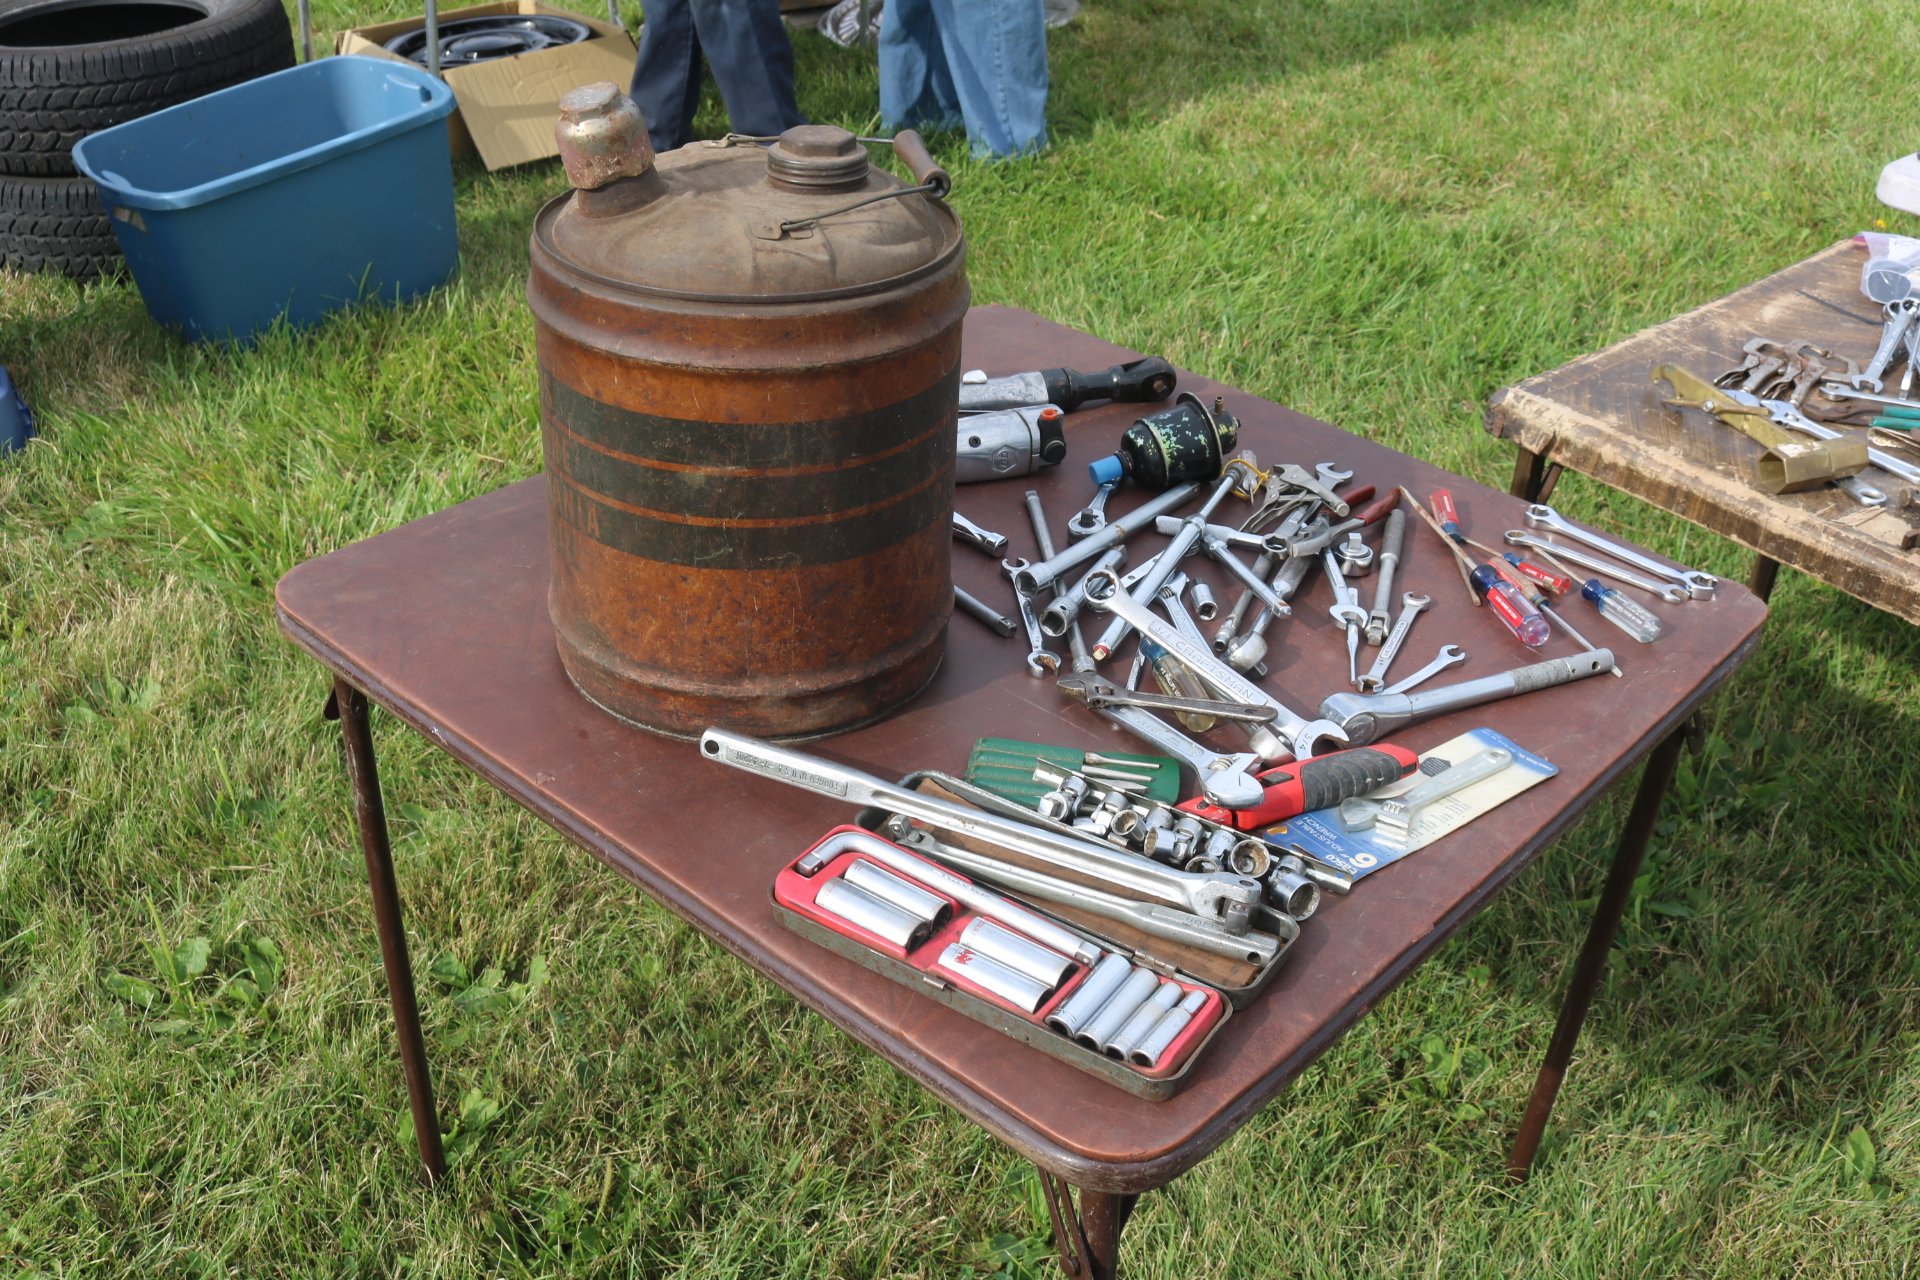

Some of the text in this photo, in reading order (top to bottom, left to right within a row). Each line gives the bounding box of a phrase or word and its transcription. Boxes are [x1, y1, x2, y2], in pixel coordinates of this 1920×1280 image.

[1155, 627, 1255, 700] 3/4 CRAFTSMAN
[1299, 732, 1314, 751] 3/4
[809, 774, 839, 791] FORGED
[1295, 819, 1346, 852] ADJUSTABLE
[1302, 816, 1338, 840] WRENCH
